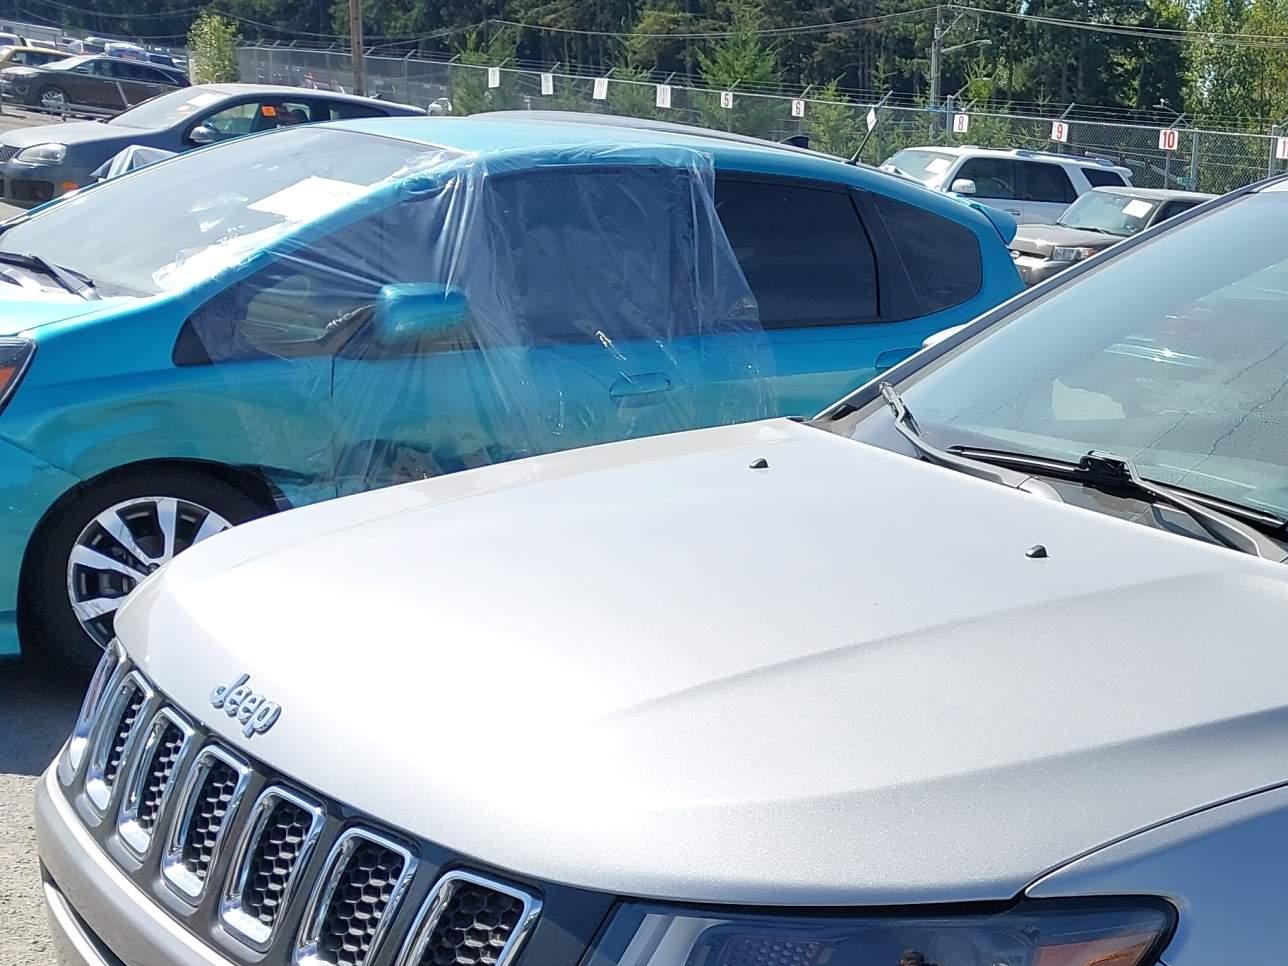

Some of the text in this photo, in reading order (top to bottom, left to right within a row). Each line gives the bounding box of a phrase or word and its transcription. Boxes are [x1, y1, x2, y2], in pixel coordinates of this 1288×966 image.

[957, 116, 965, 132] 8
[1055, 124, 1064, 140] 9
[1162, 131, 1176, 148] 10
[209, 673, 282, 739] Jeep
